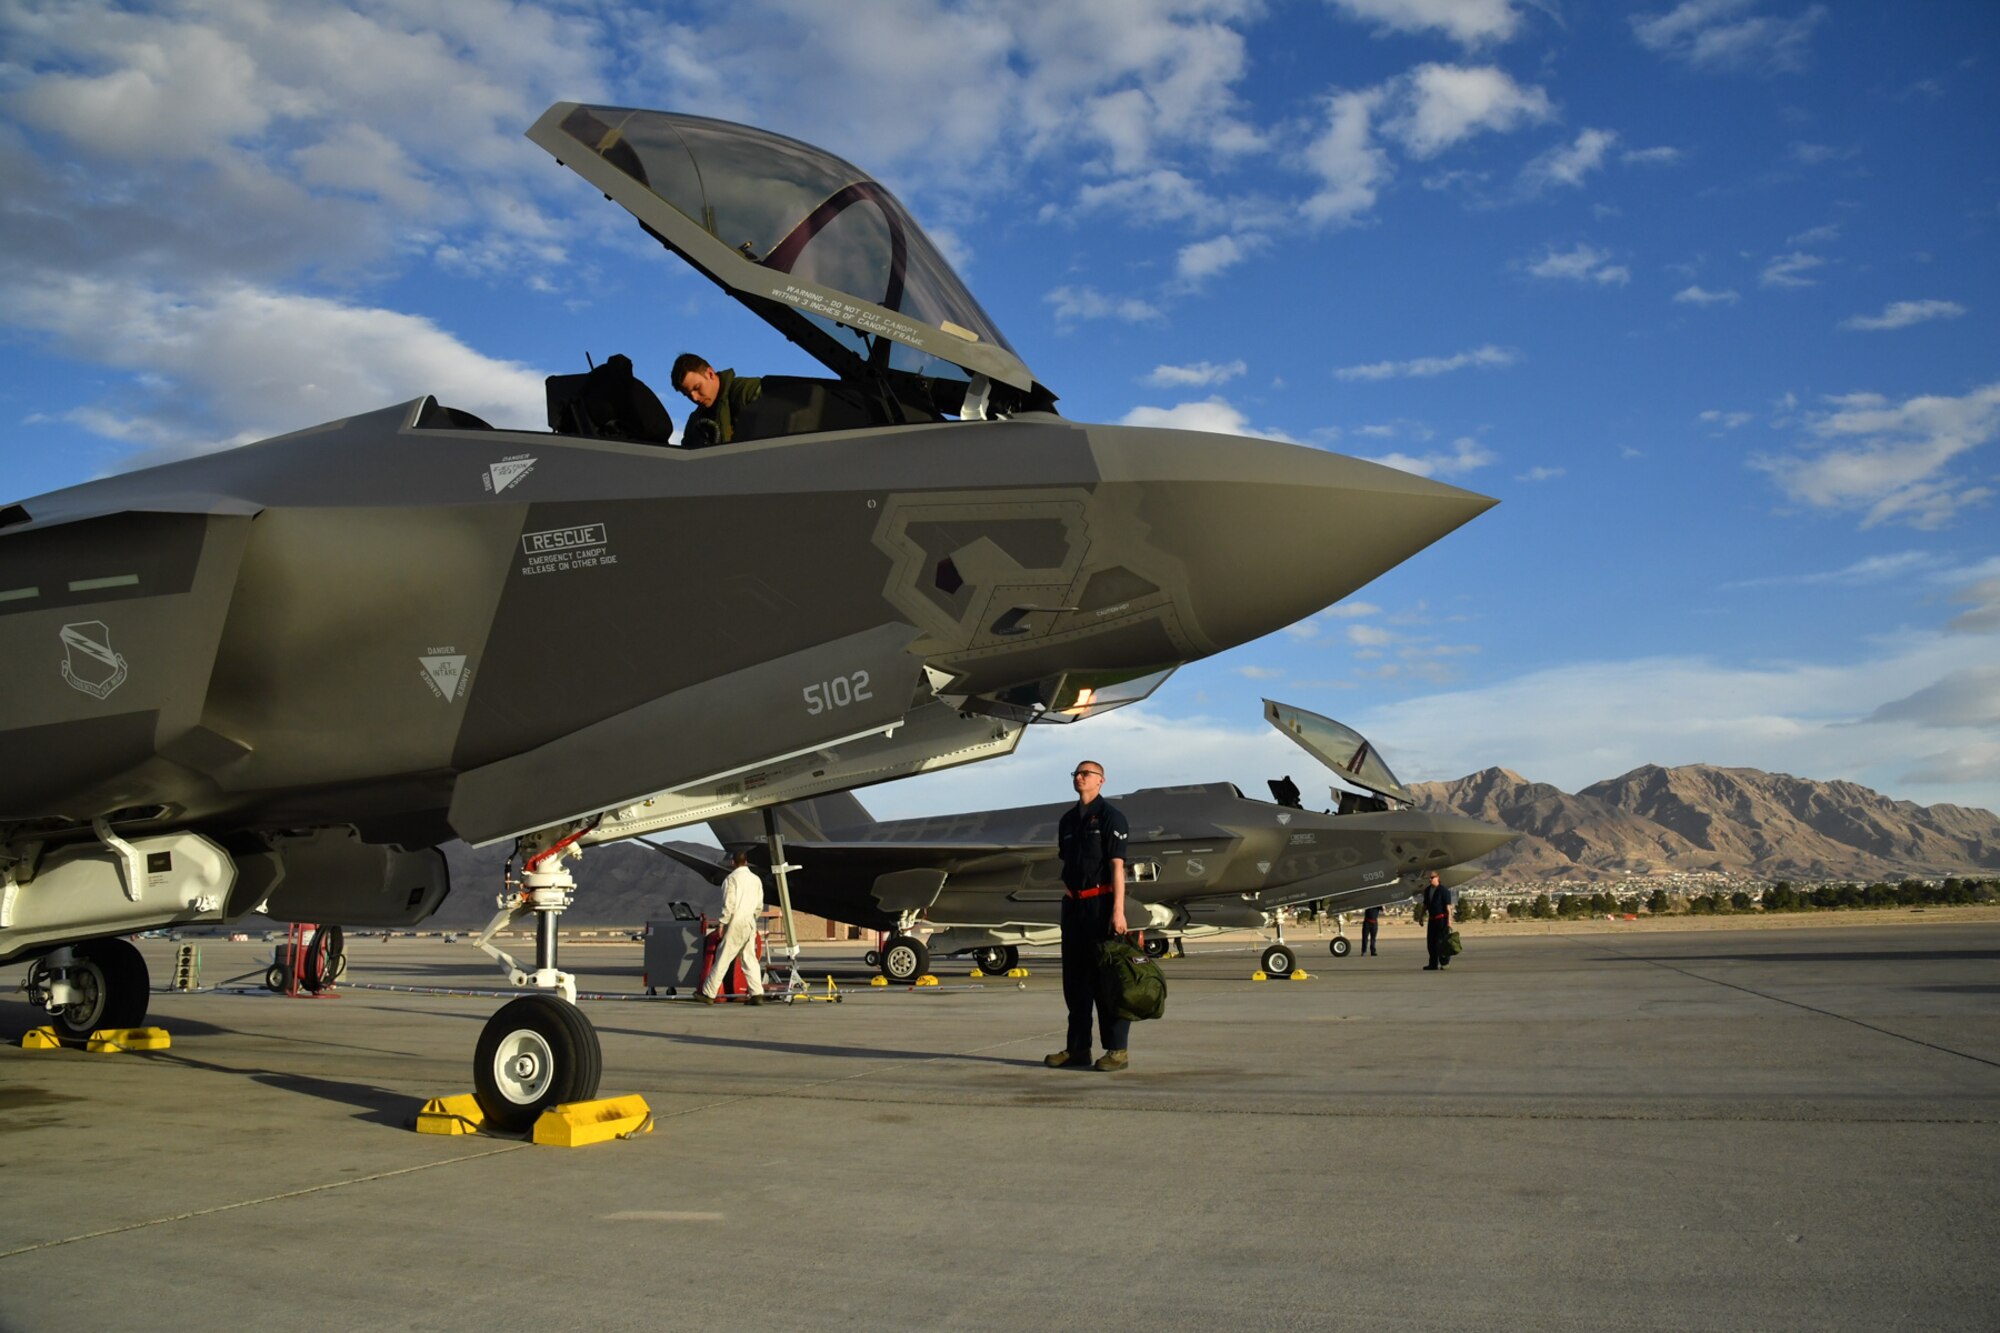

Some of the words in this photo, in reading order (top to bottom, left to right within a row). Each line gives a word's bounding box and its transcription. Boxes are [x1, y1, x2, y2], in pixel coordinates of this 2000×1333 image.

[772, 289, 800, 303] WITHIN
[810, 302, 840, 317] INCHES
[842, 313, 855, 321] OF
[857, 317, 891, 334] CANOPY
[893, 330, 925, 346] FRAME
[786, 285, 824, 302] WARNING
[830, 300, 842, 308] DO
[844, 304, 861, 315] NOT
[863, 311, 881, 322] CUT
[884, 319, 919, 335] CANOPY
[533, 528, 596, 550] RESCUE
[522, 563, 556, 575] RELEASE
[558, 562, 570, 571] ON
[572, 558, 598, 569] OTHER
[600, 555, 618, 565] SIDE
[528, 552, 573, 566] EMERGENCY
[576, 547, 607, 559] CANOPY
[803, 670, 873, 715] 5102
[1362, 870, 1385, 881] 5090
